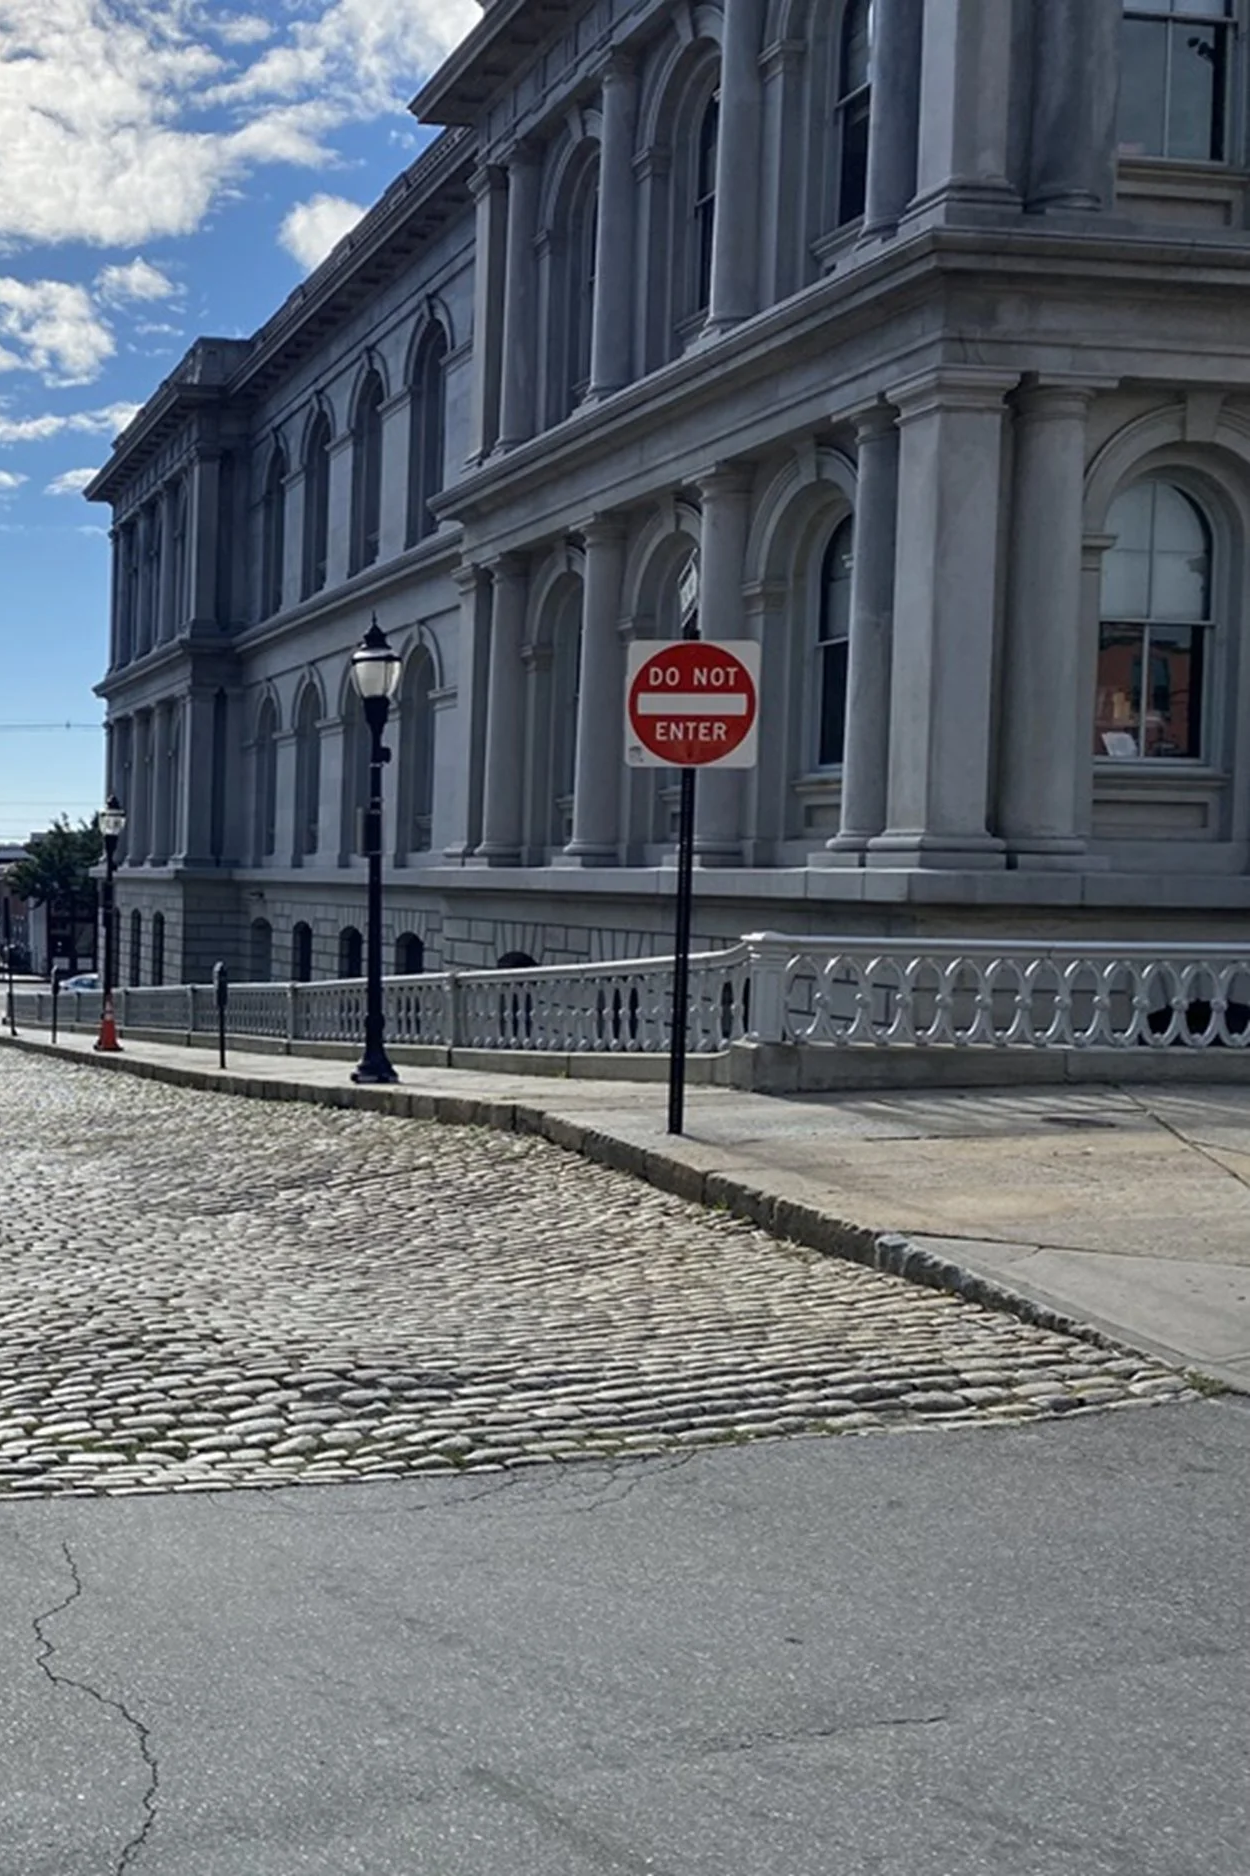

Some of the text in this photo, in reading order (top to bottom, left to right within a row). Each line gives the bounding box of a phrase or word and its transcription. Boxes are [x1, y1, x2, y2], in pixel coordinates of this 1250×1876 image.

[649, 667, 738, 686] DO NOT
[655, 721, 727, 741] ENTER
